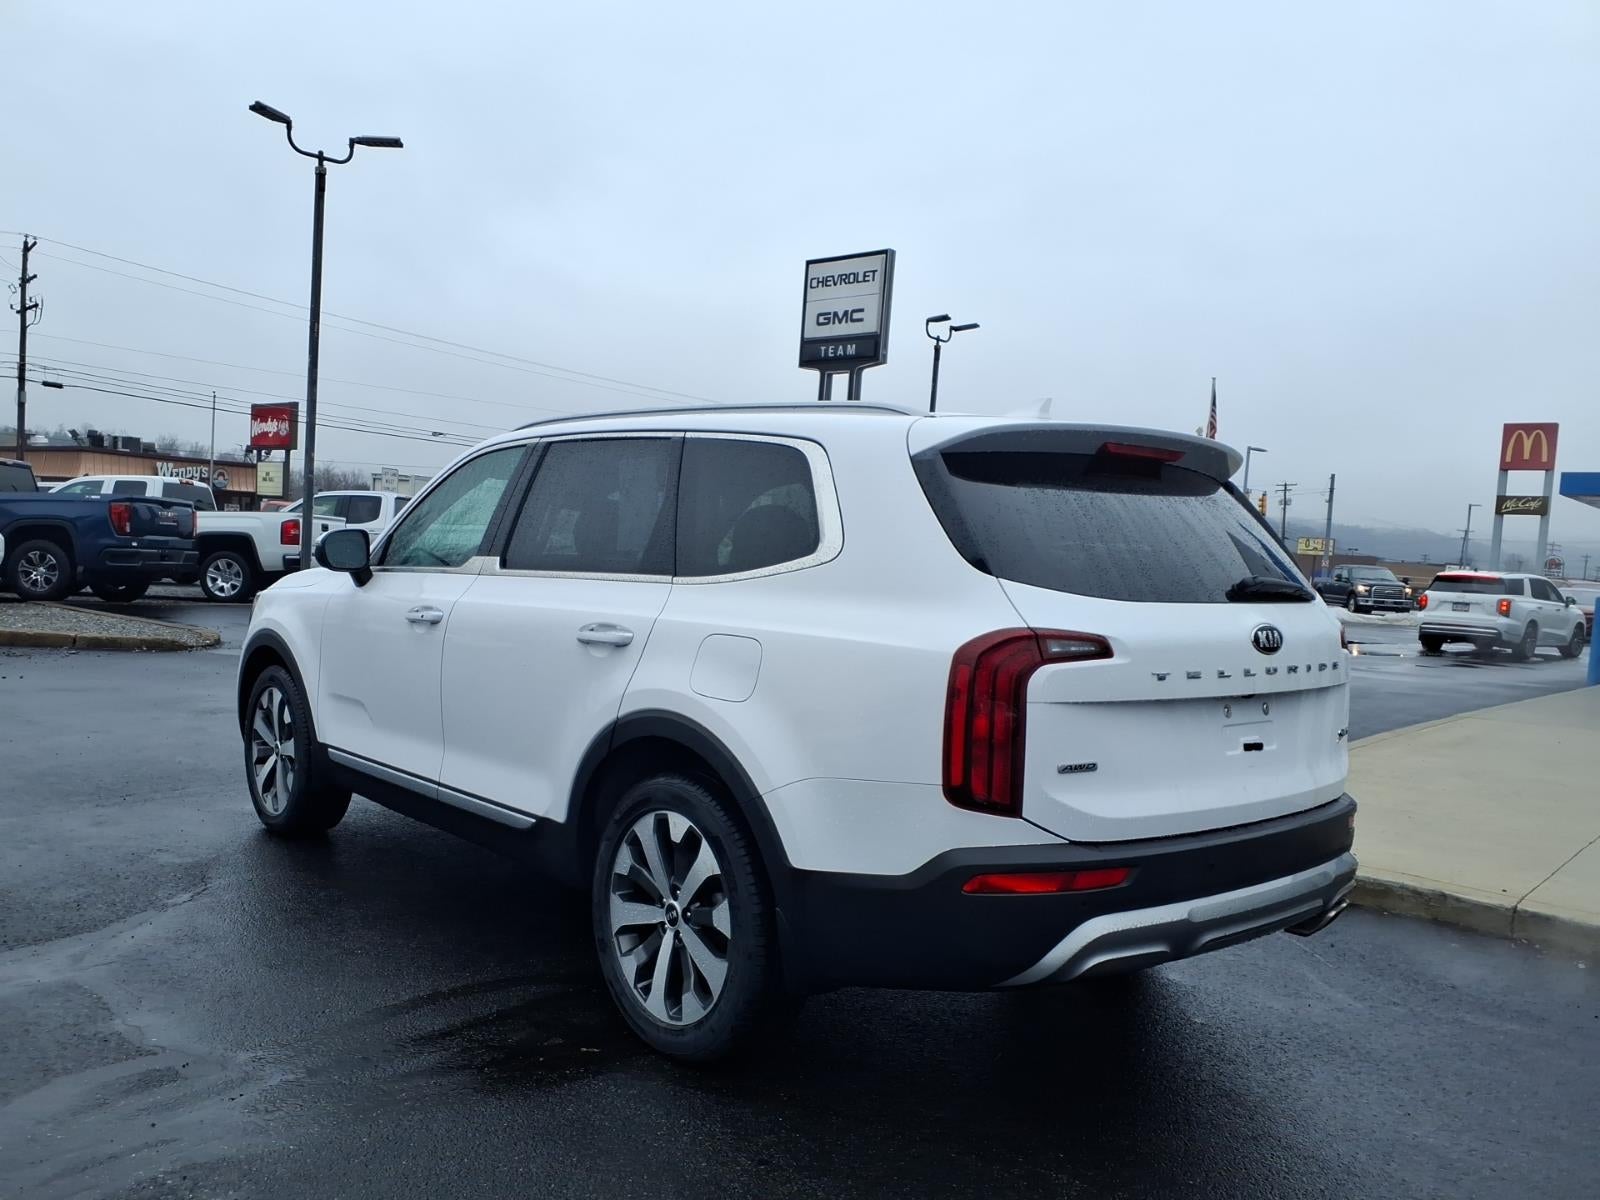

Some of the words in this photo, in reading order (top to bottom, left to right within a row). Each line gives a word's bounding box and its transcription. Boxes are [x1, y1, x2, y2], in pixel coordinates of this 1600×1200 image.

[810, 269, 878, 289] CHEVROLET
[816, 308, 865, 326] GMC
[820, 344, 856, 357] TEAM
[1257, 629, 1280, 648] KIA
[1152, 662, 1340, 681] TELLURIDE
[1061, 763, 1097, 772] AWD
